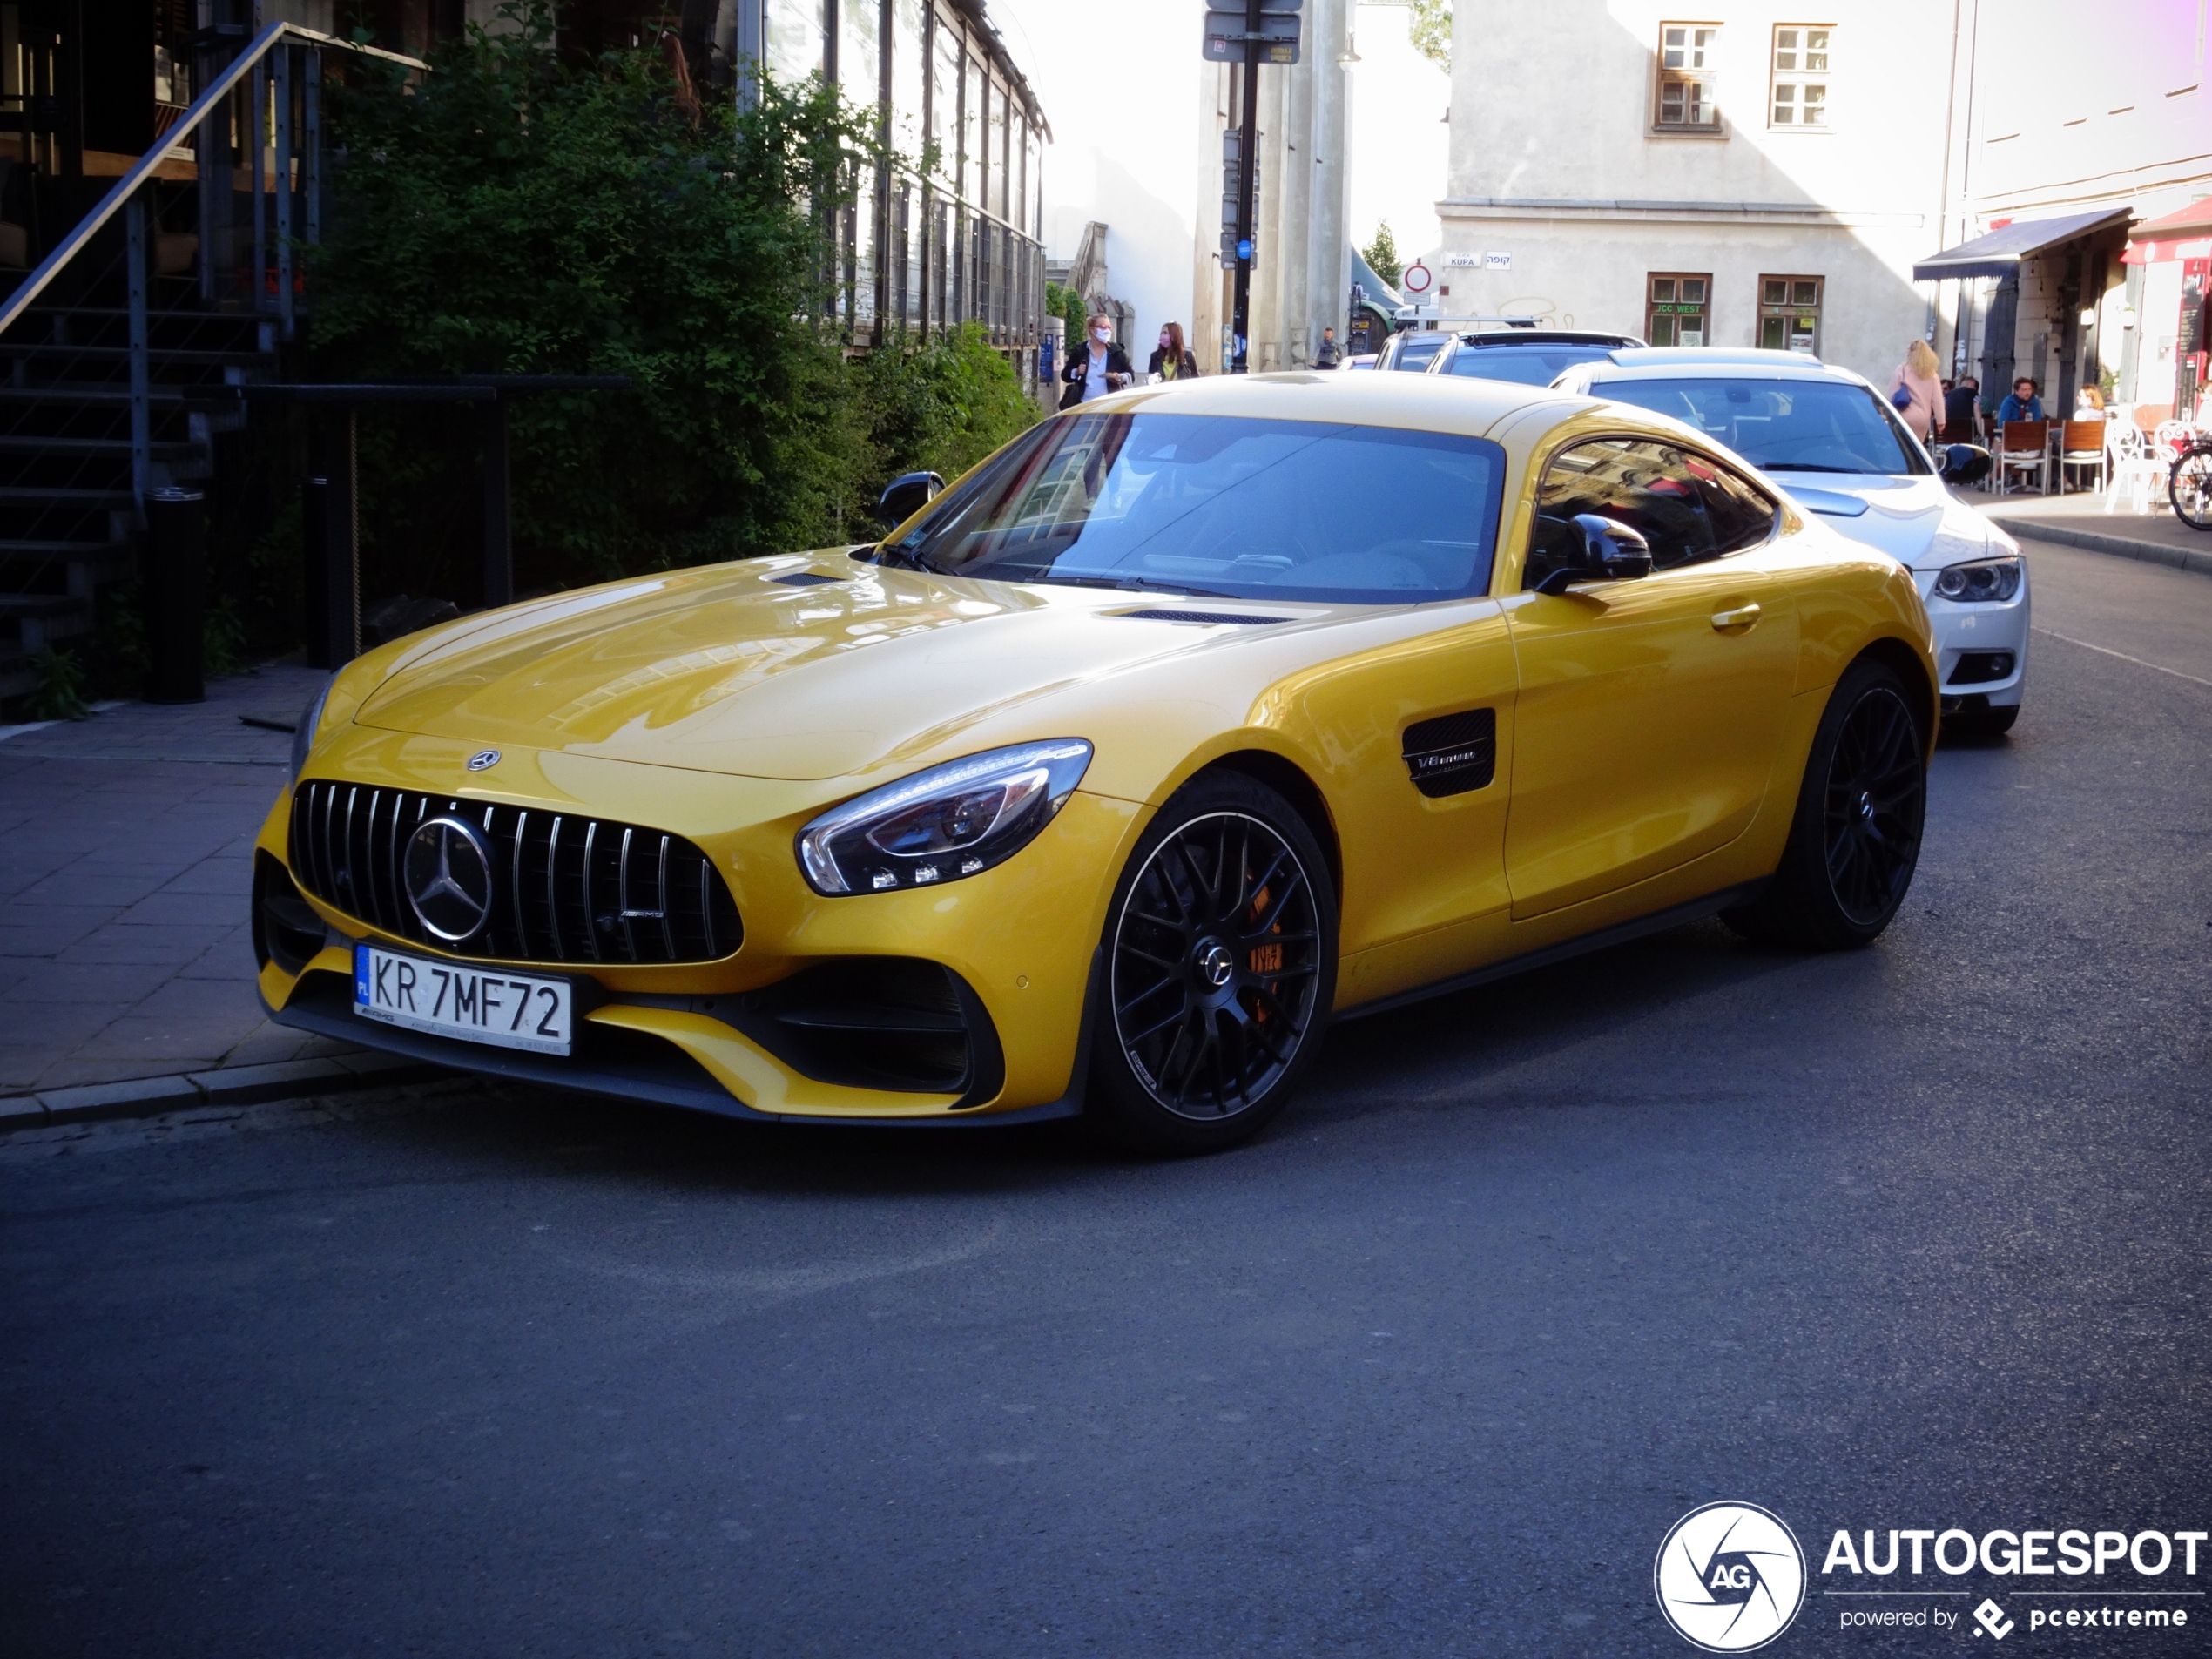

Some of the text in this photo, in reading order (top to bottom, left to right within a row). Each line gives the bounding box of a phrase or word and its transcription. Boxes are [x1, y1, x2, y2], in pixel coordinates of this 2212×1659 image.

[1487, 256, 1510, 266] קופה
[1656, 304, 1701, 314] JCC WEST
[1417, 755, 1439, 768] V8
[358, 982, 368, 997] PL
[375, 955, 560, 1038] KR 7MF72
